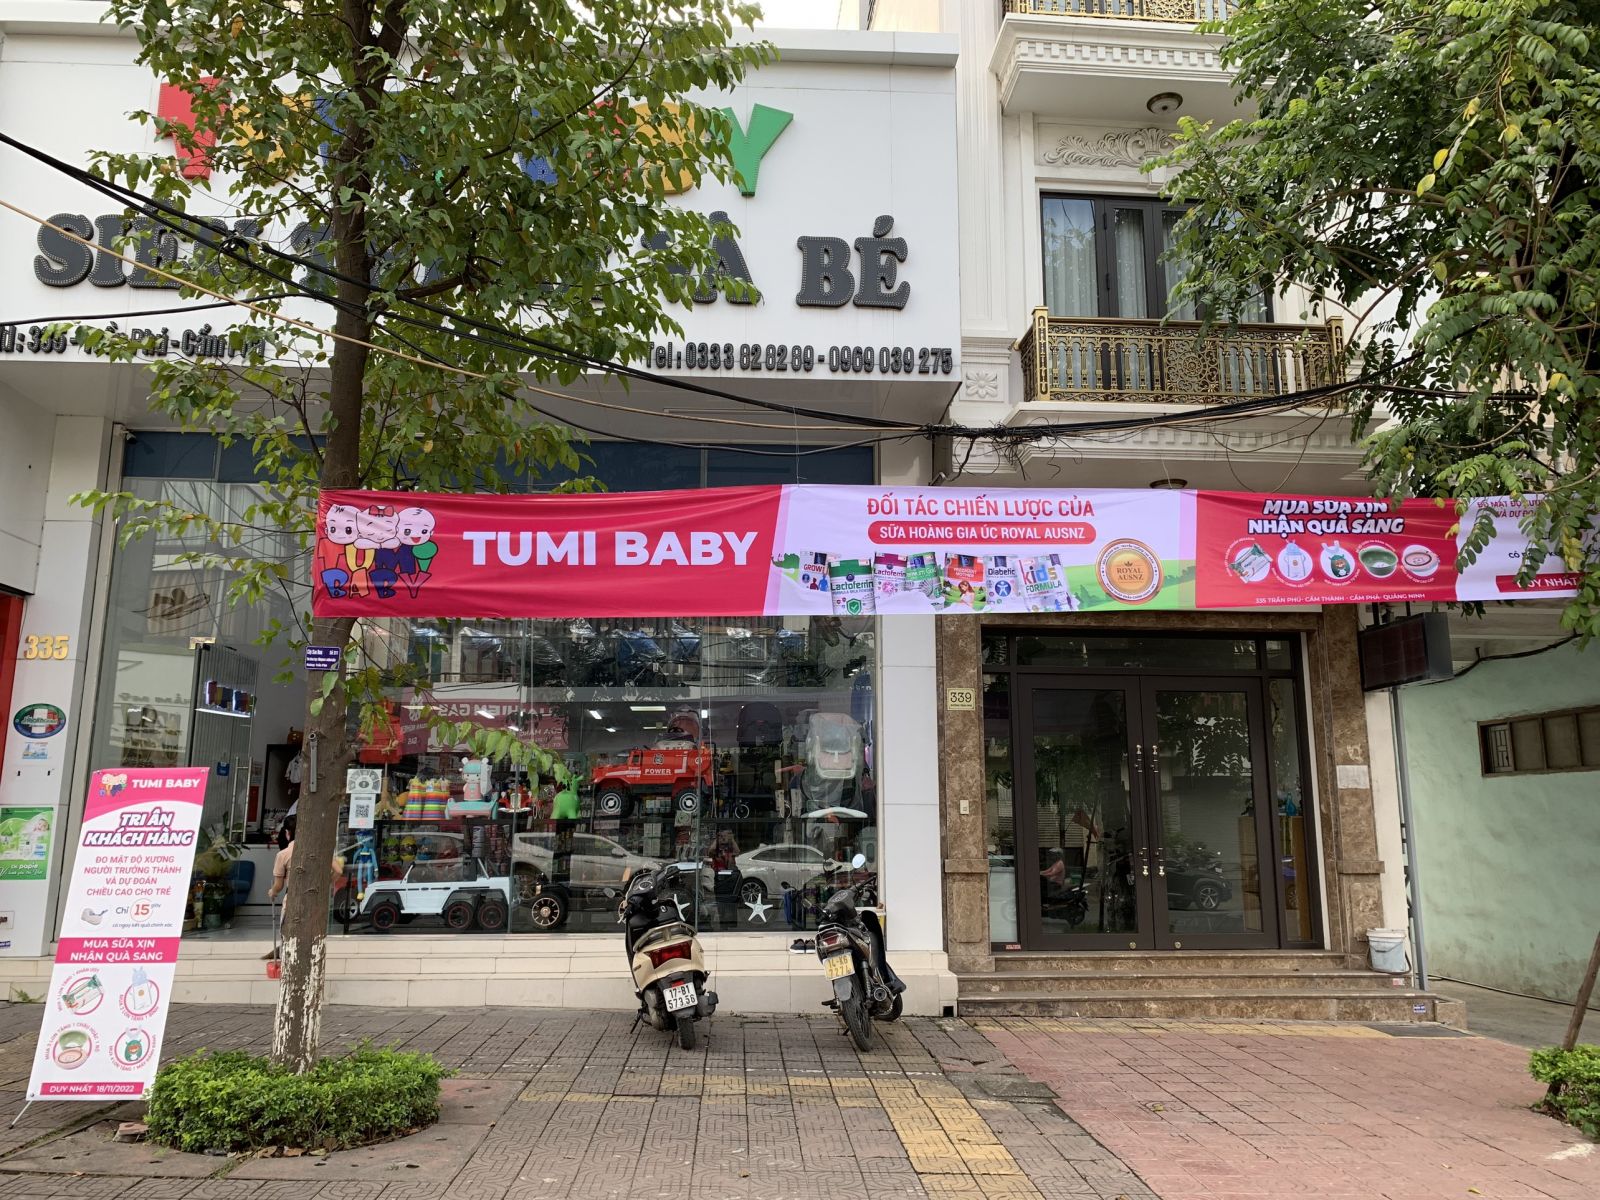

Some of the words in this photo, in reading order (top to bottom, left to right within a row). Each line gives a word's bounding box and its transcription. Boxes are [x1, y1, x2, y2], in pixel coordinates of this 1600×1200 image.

[796, 215, 911, 310] BÉ
[182, 323, 225, 357] Cẩm
[686, 342, 734, 370] 0333
[829, 345, 874, 372] 0969
[879, 346, 914, 373] 039
[918, 347, 953, 374] 275
[867, 492, 899, 515] ĐỐI
[904, 494, 938, 516] TÁC
[944, 493, 998, 516] CHIẾN
[1005, 499, 1053, 520] LƯỢC
[1058, 495, 1094, 517] CỦA
[1263, 499, 1309, 515] MUA
[880, 523, 906, 539] SỮA
[909, 522, 953, 539] HOÀNG
[956, 526, 977, 539] GIA
[980, 524, 998, 539] ÚC
[1001, 527, 1041, 539] ROYAL
[1044, 527, 1085, 539] AUSNZ
[1248, 514, 1305, 538] NHẬN
[1307, 513, 1349, 535] QUÀ
[1352, 518, 1404, 535] SANG
[463, 531, 596, 566] TUMI
[615, 531, 758, 567] BABY
[987, 567, 1016, 576] Diabetic
[1019, 559, 1058, 584] kids
[320, 567, 432, 599] BABY
[831, 580, 874, 591] Lactoferrin
[1025, 581, 1063, 593] FORMULA
[24, 635, 70, 660] 335
[950, 692, 972, 703] 339
[131, 779, 162, 789] TUMI
[166, 778, 200, 788] BABY
[120, 812, 147, 828] TRI
[147, 806, 175, 828] ÂN
[82, 827, 145, 847] KHÁCH
[131, 855, 142, 864] ĐỘ
[144, 855, 174, 863] XƯƠNG
[84, 866, 111, 874] NGƯỜI
[152, 866, 181, 874] THÀNH
[105, 877, 117, 885] VÀ
[119, 877, 131, 886] DỰ
[133, 876, 158, 885] ĐOÁN
[156, 887, 171, 895] TRẺ
[134, 904, 150, 916] 15
[83, 940, 109, 948] MUA
[111, 938, 134, 948] SỮA
[136, 939, 155, 951] XỊN
[70, 951, 103, 964] NHẬN
[106, 951, 131, 963] QUÀ
[133, 951, 163, 961] SANG
[69, 1084, 93, 1092] NHẤT
